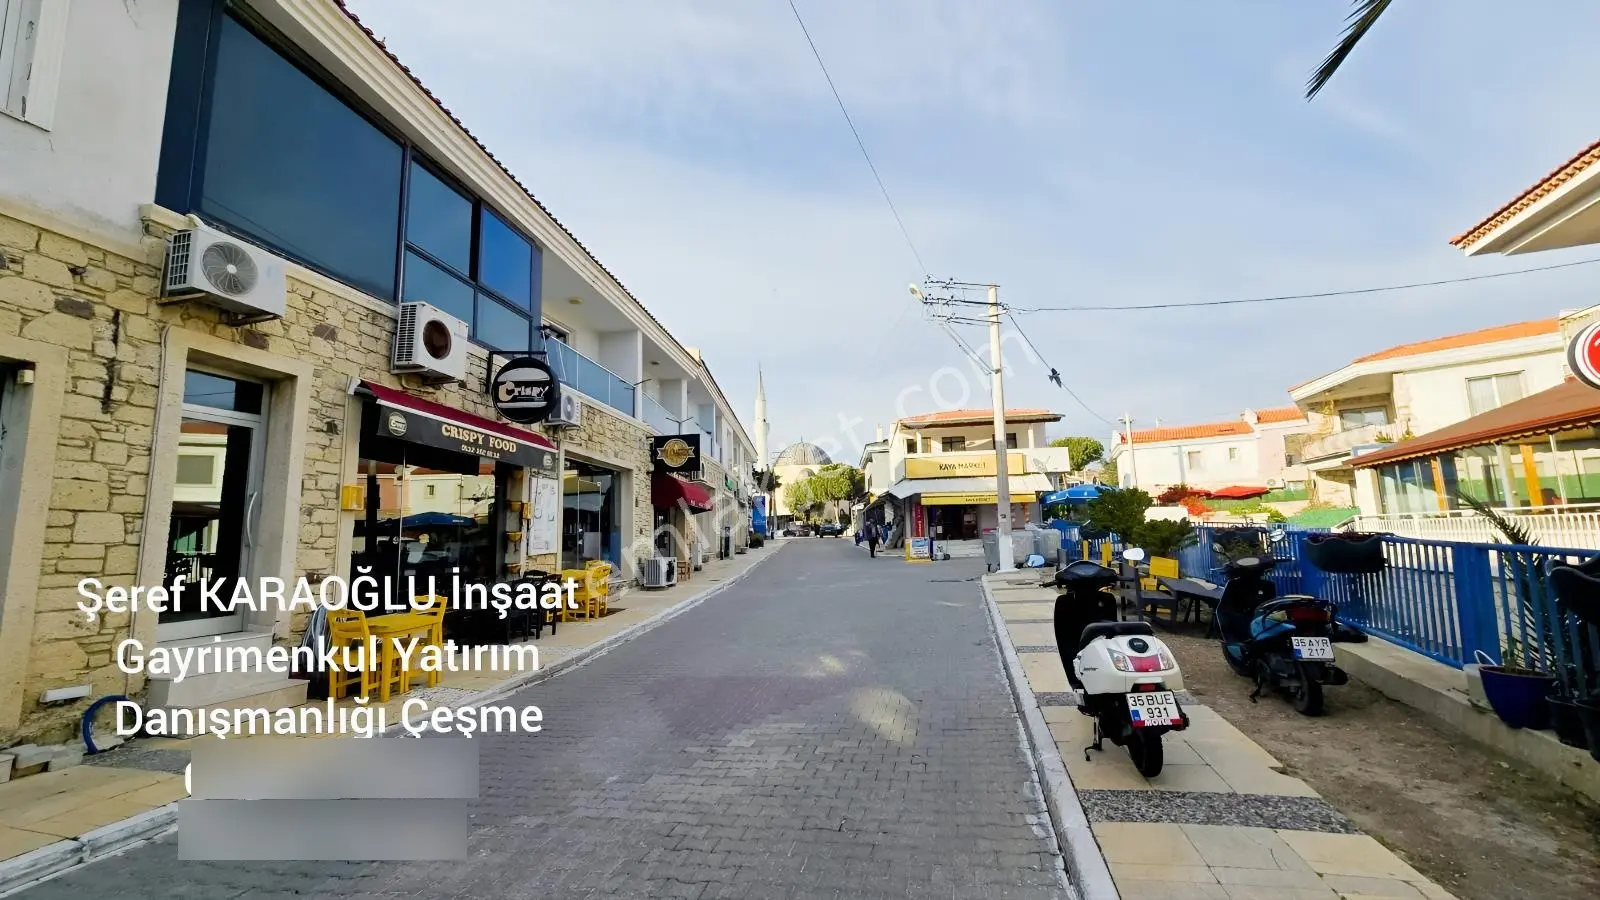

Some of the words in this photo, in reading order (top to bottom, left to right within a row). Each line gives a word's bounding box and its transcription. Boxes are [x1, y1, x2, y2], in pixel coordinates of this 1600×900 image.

[441, 424, 485, 445] CRISPY
[489, 436, 517, 453] FOOD
[939, 463, 957, 471] KAYA
[1308, 648, 1325, 656] 217
[1129, 695, 1145, 707] 35
[1145, 693, 1174, 706] BUE
[1146, 706, 1169, 719] 931
